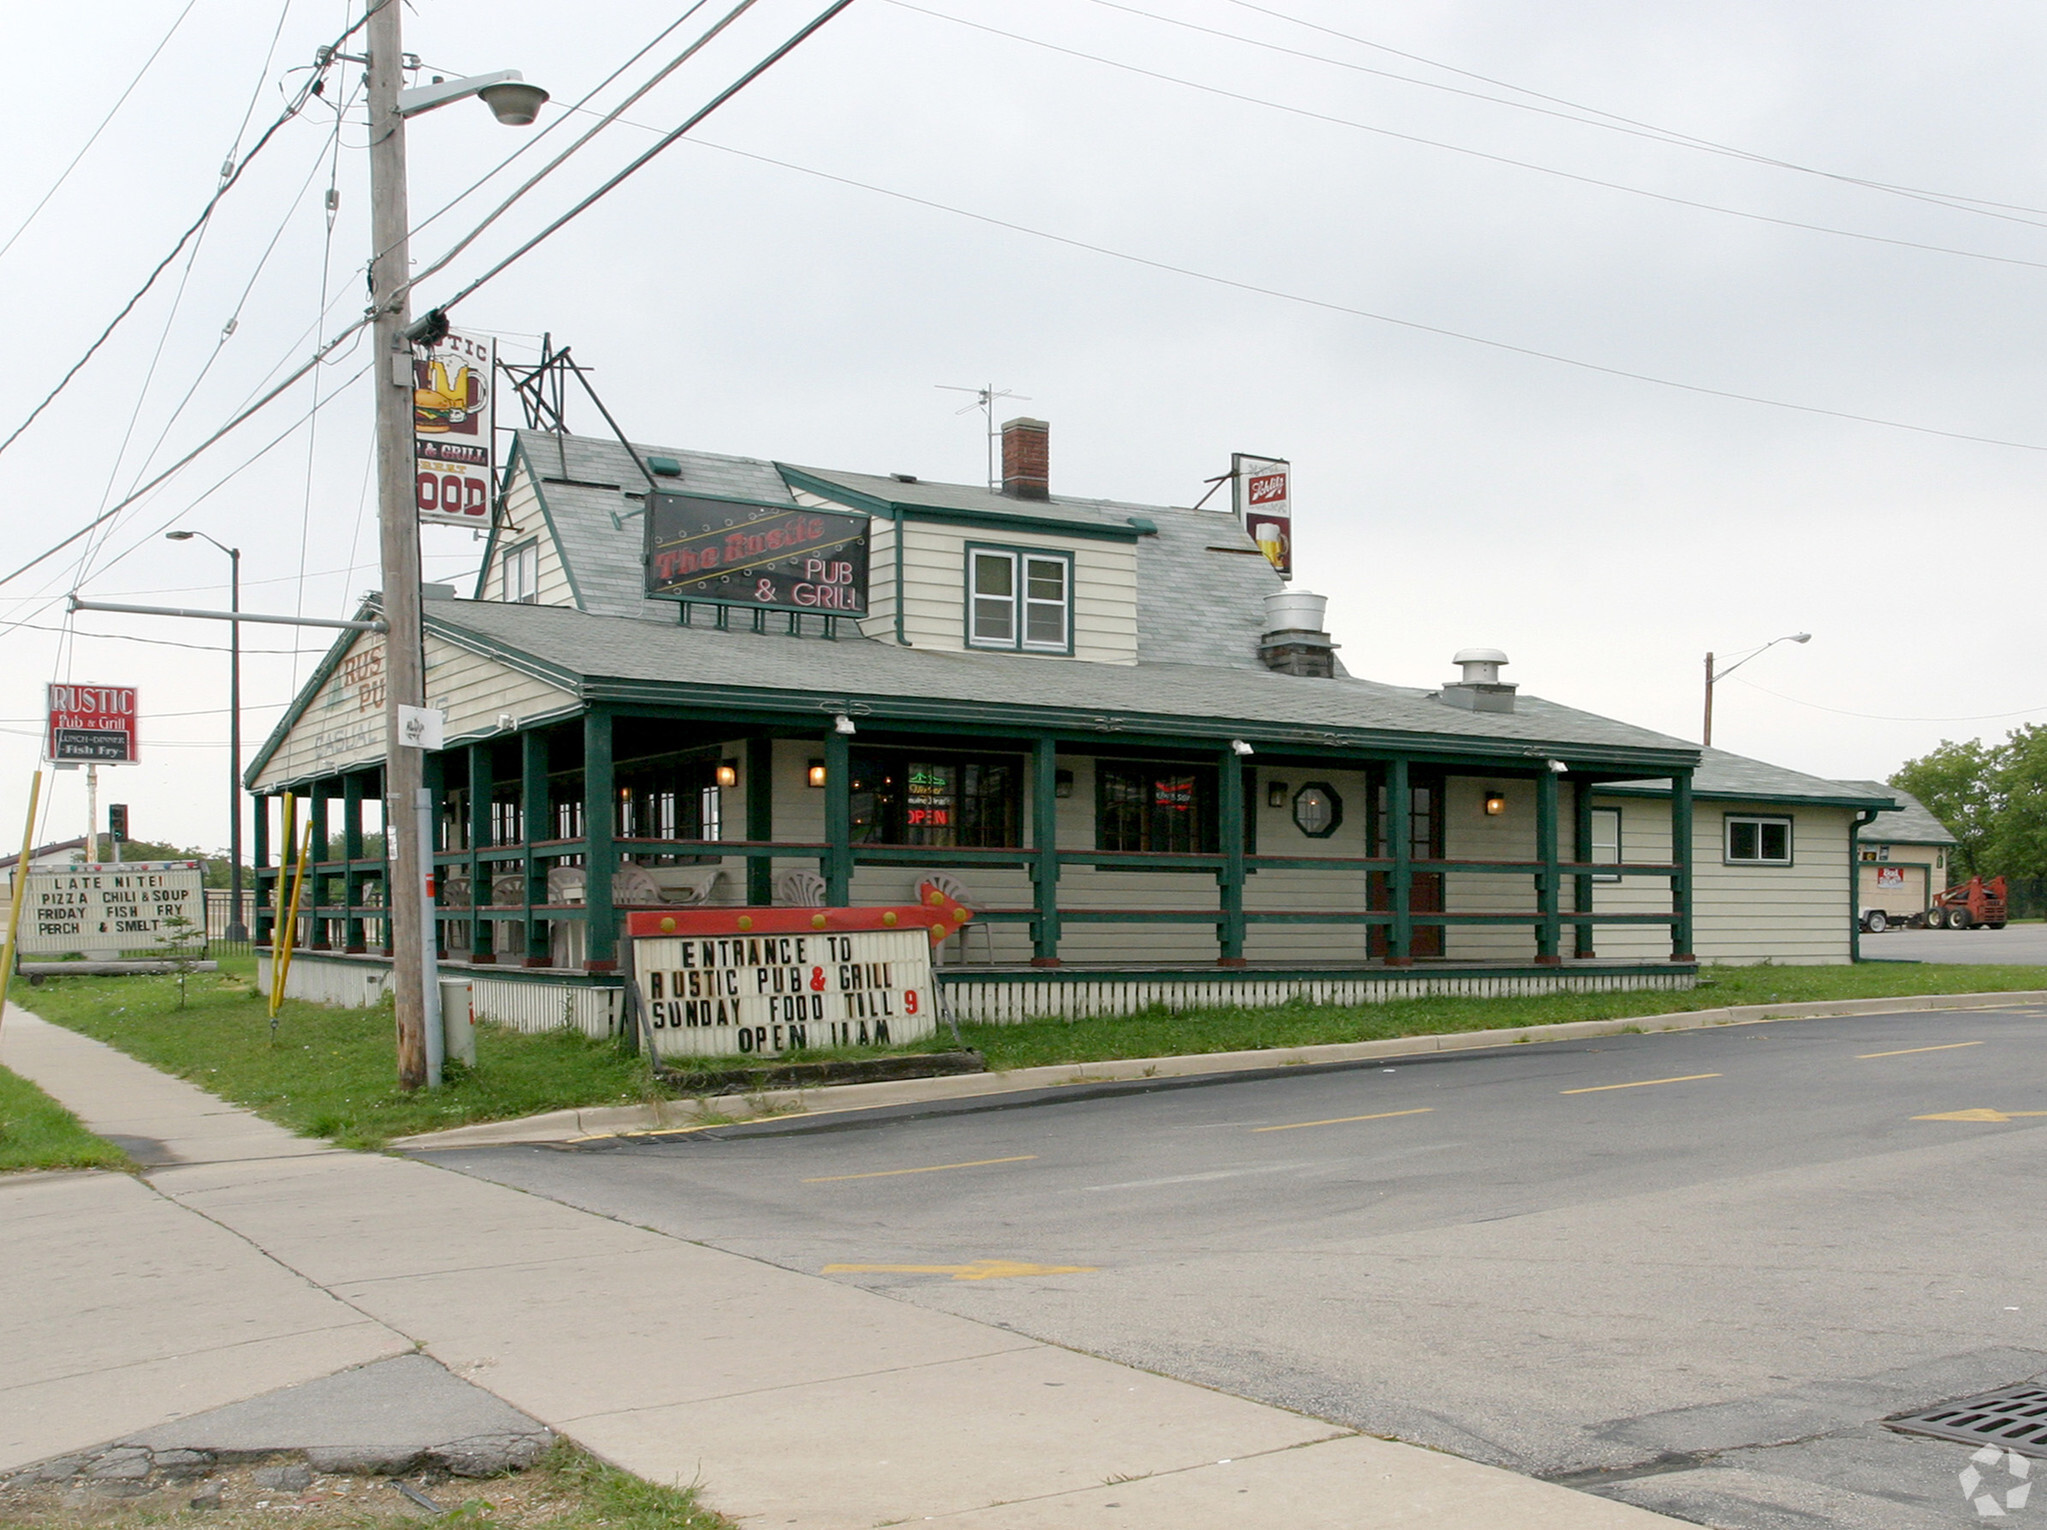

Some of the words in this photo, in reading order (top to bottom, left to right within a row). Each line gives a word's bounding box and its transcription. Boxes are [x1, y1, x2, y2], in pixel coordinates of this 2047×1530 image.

[425, 443, 438, 458] &
[441, 444, 486, 462] GRILL
[416, 472, 486, 517] OOD
[654, 546, 718, 579] The
[723, 516, 824, 563] Rustic
[806, 558, 853, 585] PUB
[755, 578, 777, 602] &
[791, 582, 862, 611] GRILL
[51, 686, 133, 714] RUSTIC
[359, 677, 385, 714] PU
[59, 715, 83, 728] Pub
[87, 719, 95, 728] &
[99, 717, 125, 730] Grill
[55, 877, 101, 890] LATE
[115, 875, 163, 888] NITE!
[42, 893, 88, 905] PIZZA
[103, 891, 136, 903] CHILI
[142, 891, 150, 902] &
[153, 890, 189, 902] SOUP
[38, 908, 86, 920] FRIDAY
[107, 906, 138, 917] FISH
[157, 904, 183, 916] FRY
[39, 922, 80, 936] PERCH
[99, 921, 107, 933] &
[116, 919, 160, 932] SMELT
[682, 938, 807, 967] ENTRANCE
[651, 968, 738, 999] RUSTIC
[757, 967, 802, 994] PUB
[810, 966, 826, 992] &
[839, 963, 893, 990] GRILL
[653, 998, 741, 1029] SUNDAY
[770, 993, 824, 1022] FOOD
[844, 991, 893, 1018] TILL
[903, 989, 918, 1015] 9
[737, 1024, 807, 1053] OPEN
